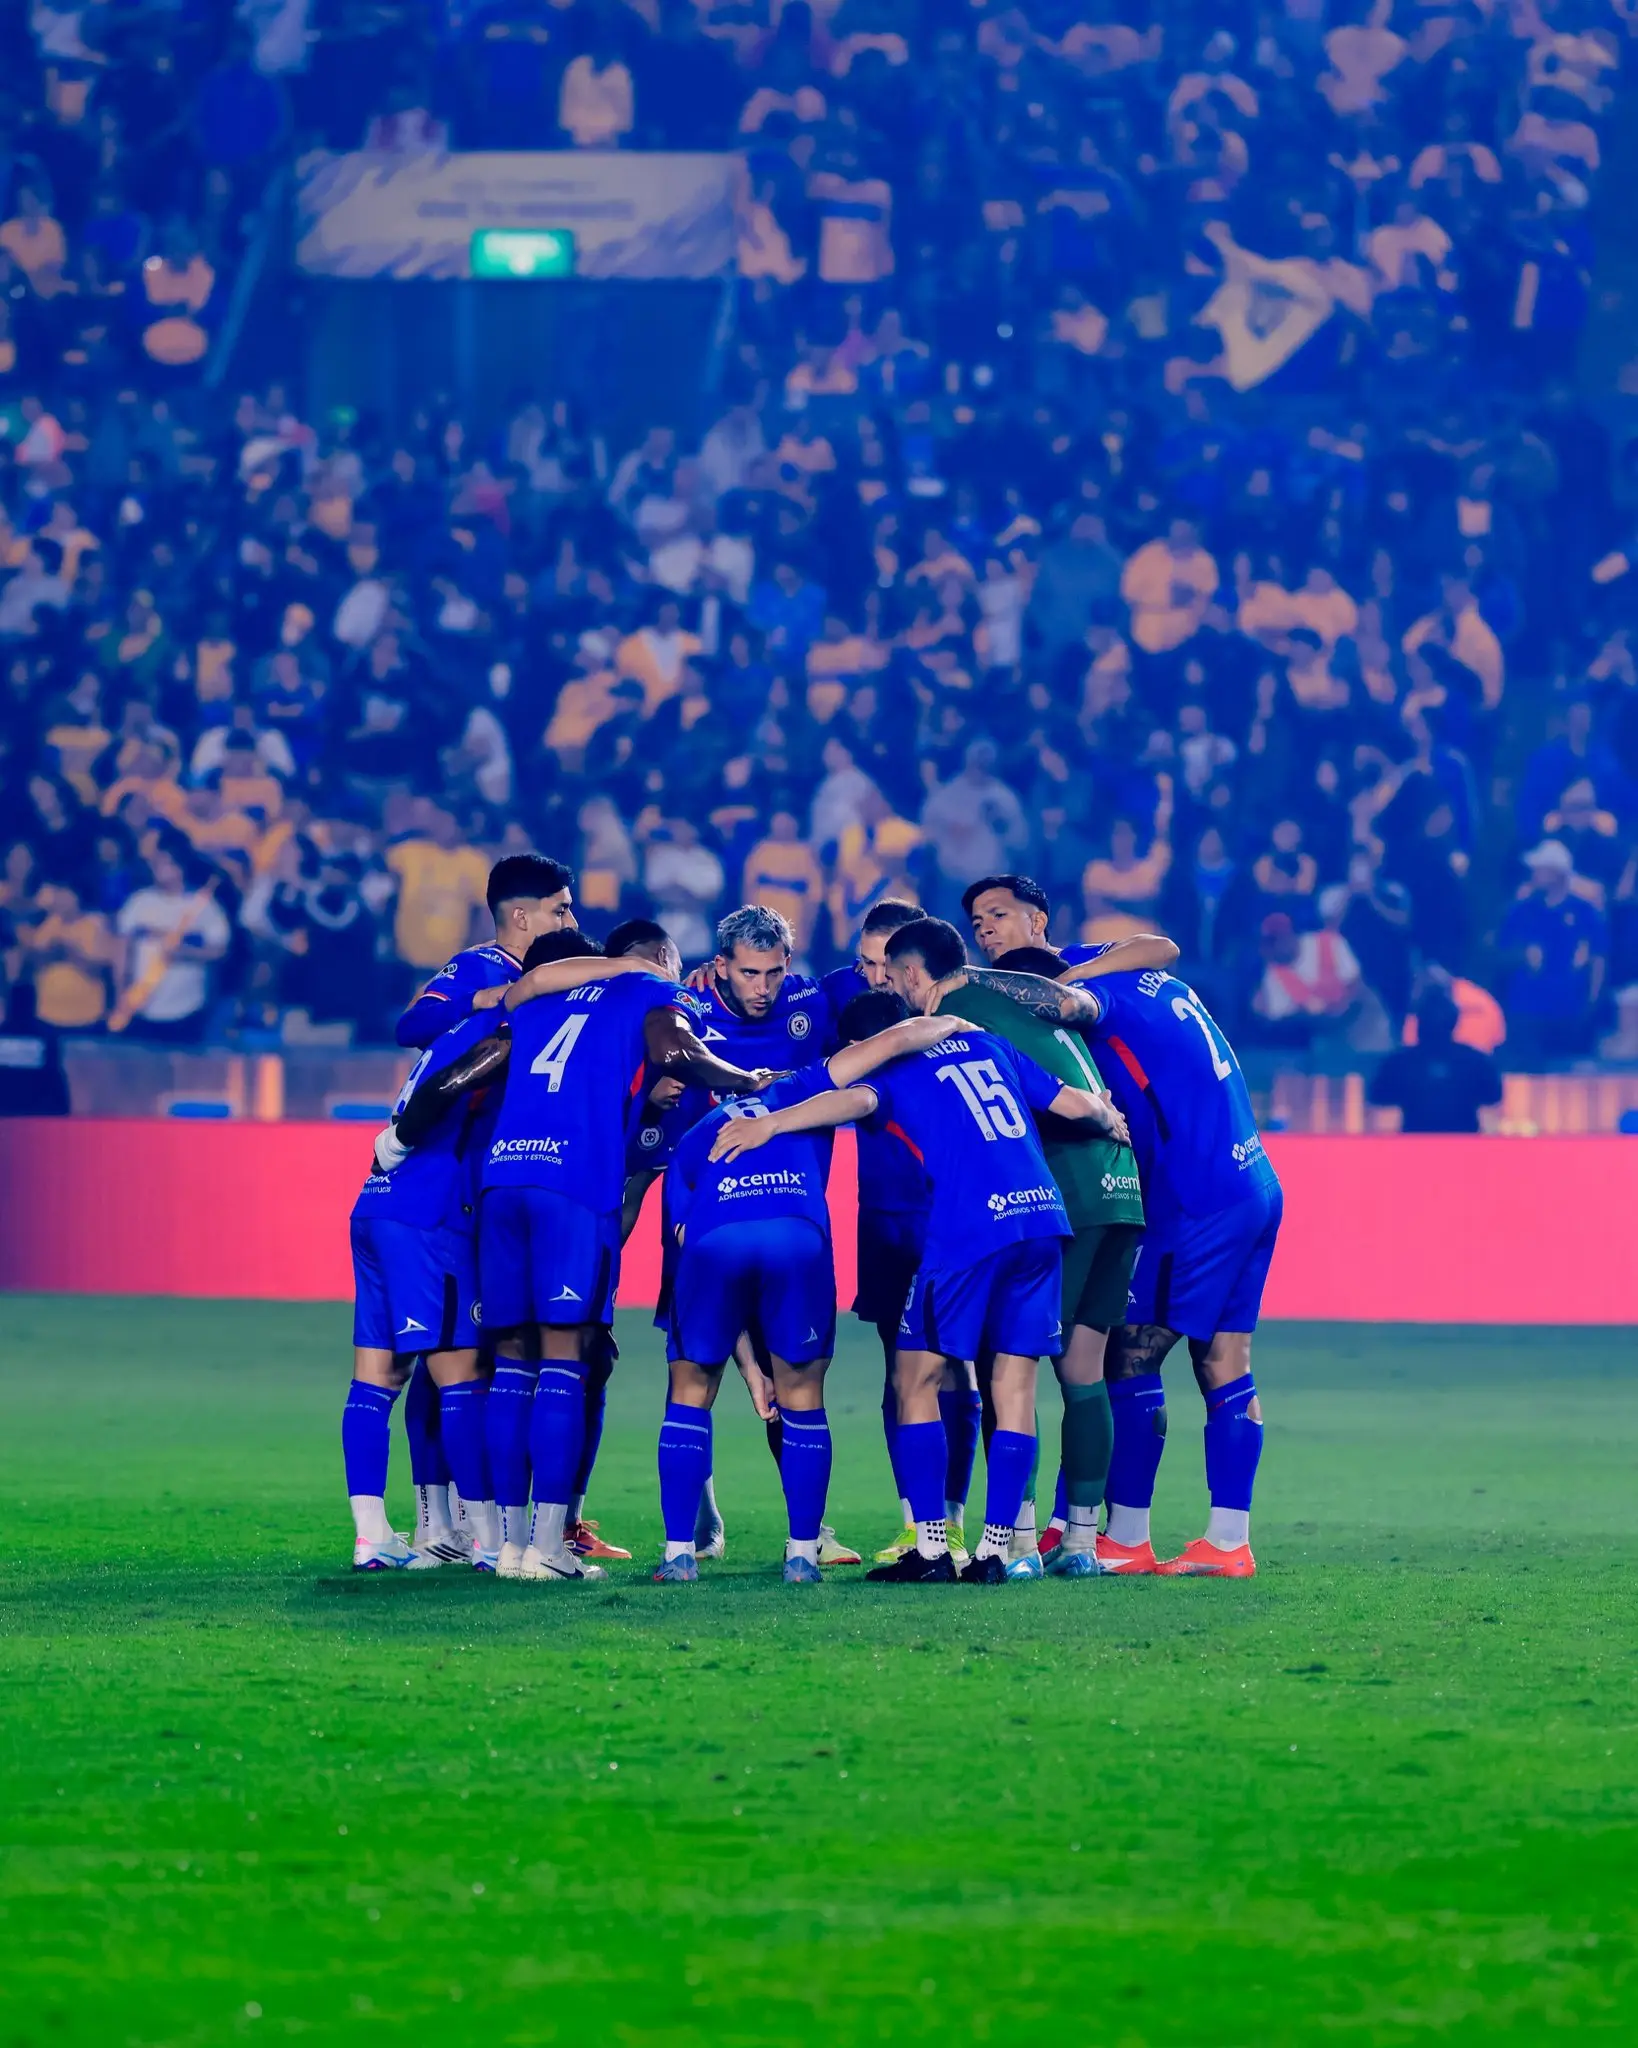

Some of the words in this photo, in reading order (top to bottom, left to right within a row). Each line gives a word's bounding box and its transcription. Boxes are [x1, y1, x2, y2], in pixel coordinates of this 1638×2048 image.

[787, 987, 819, 1003] novibet
[530, 1014, 590, 1093] 4
[935, 1058, 1027, 1142] 15
[507, 1137, 561, 1154] cemix
[739, 1169, 801, 1188] cemix
[719, 1188, 764, 1202] ADHESIVOS
[774, 1187, 808, 1197] ESTUCOS
